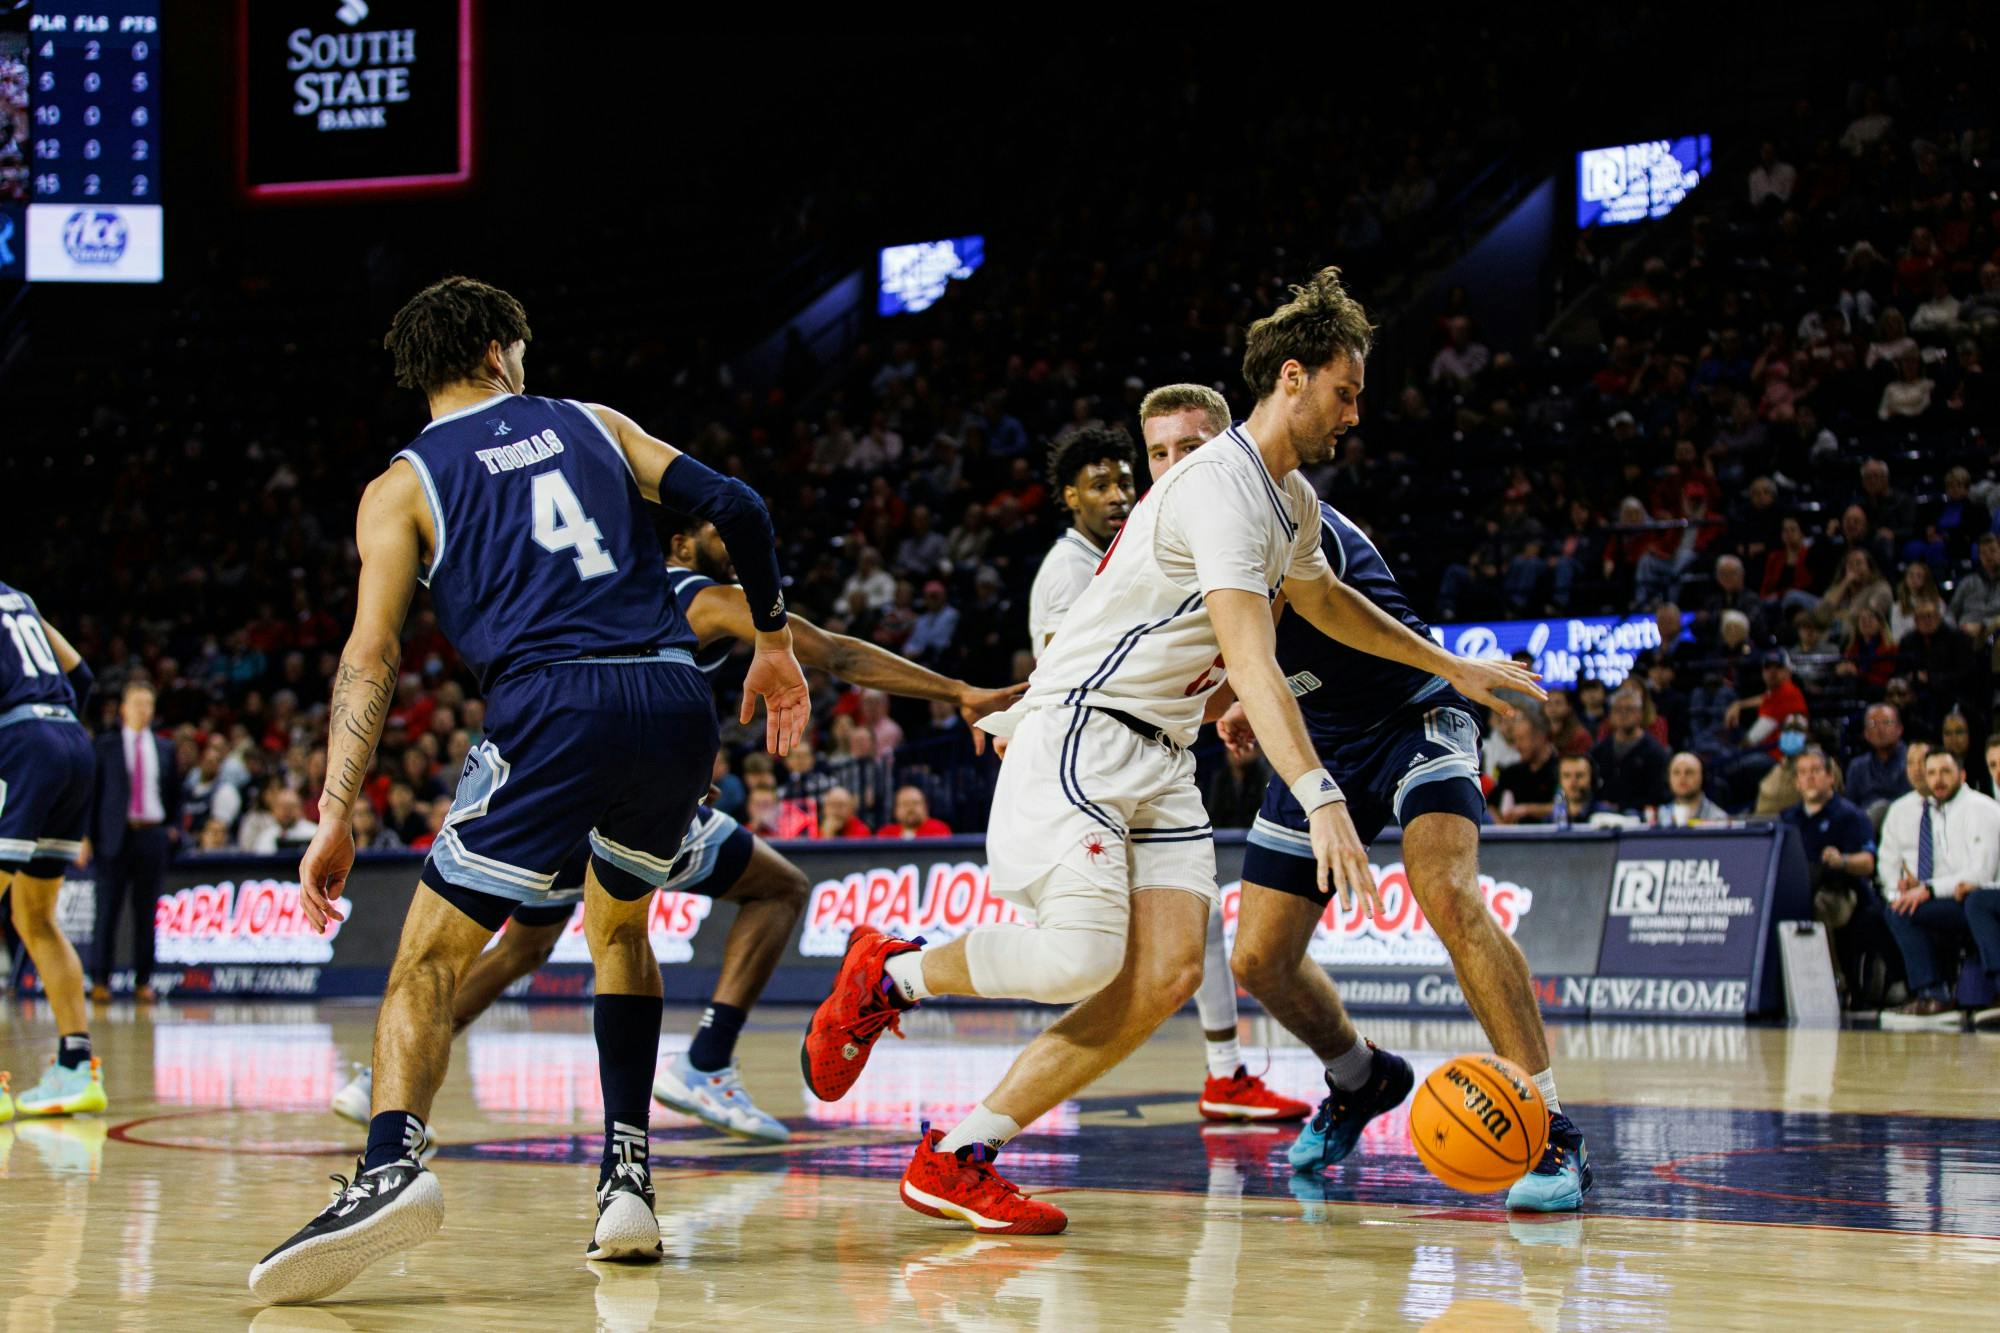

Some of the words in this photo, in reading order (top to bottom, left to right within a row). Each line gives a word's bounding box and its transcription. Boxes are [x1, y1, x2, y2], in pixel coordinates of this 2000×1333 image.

[29, 14, 66, 31] PLR
[74, 15, 109, 32] FLS
[119, 15, 157, 33] PTS
[39, 40, 54, 58] 4
[85, 40, 101, 60] 2
[131, 41, 148, 61] 0
[287, 28, 416, 70] SOUTH
[39, 71, 55, 92] 5
[84, 72, 101, 93] 0
[131, 72, 148, 93] 5
[293, 67, 410, 116] STATE
[35, 105, 60, 126] 10
[84, 105, 101, 126] 0
[131, 106, 148, 127] 6
[317, 106, 387, 132] BANK
[35, 138, 60, 160] 12
[84, 139, 101, 160] 0
[131, 139, 148, 161] 2
[35, 173, 60, 194] 15
[84, 174, 101, 195] 2
[131, 174, 148, 196] 2
[475, 429, 564, 475] THOMAS
[531, 469, 618, 581] 4
[2, 612, 60, 677] 10
[1667, 859, 1720, 883] REAL
[813, 872, 911, 926] PAPA
[1664, 882, 1730, 899] PROPERTY
[1416, 974, 1465, 1006] Gro
[1445, 1066, 1513, 1142] Wilson
